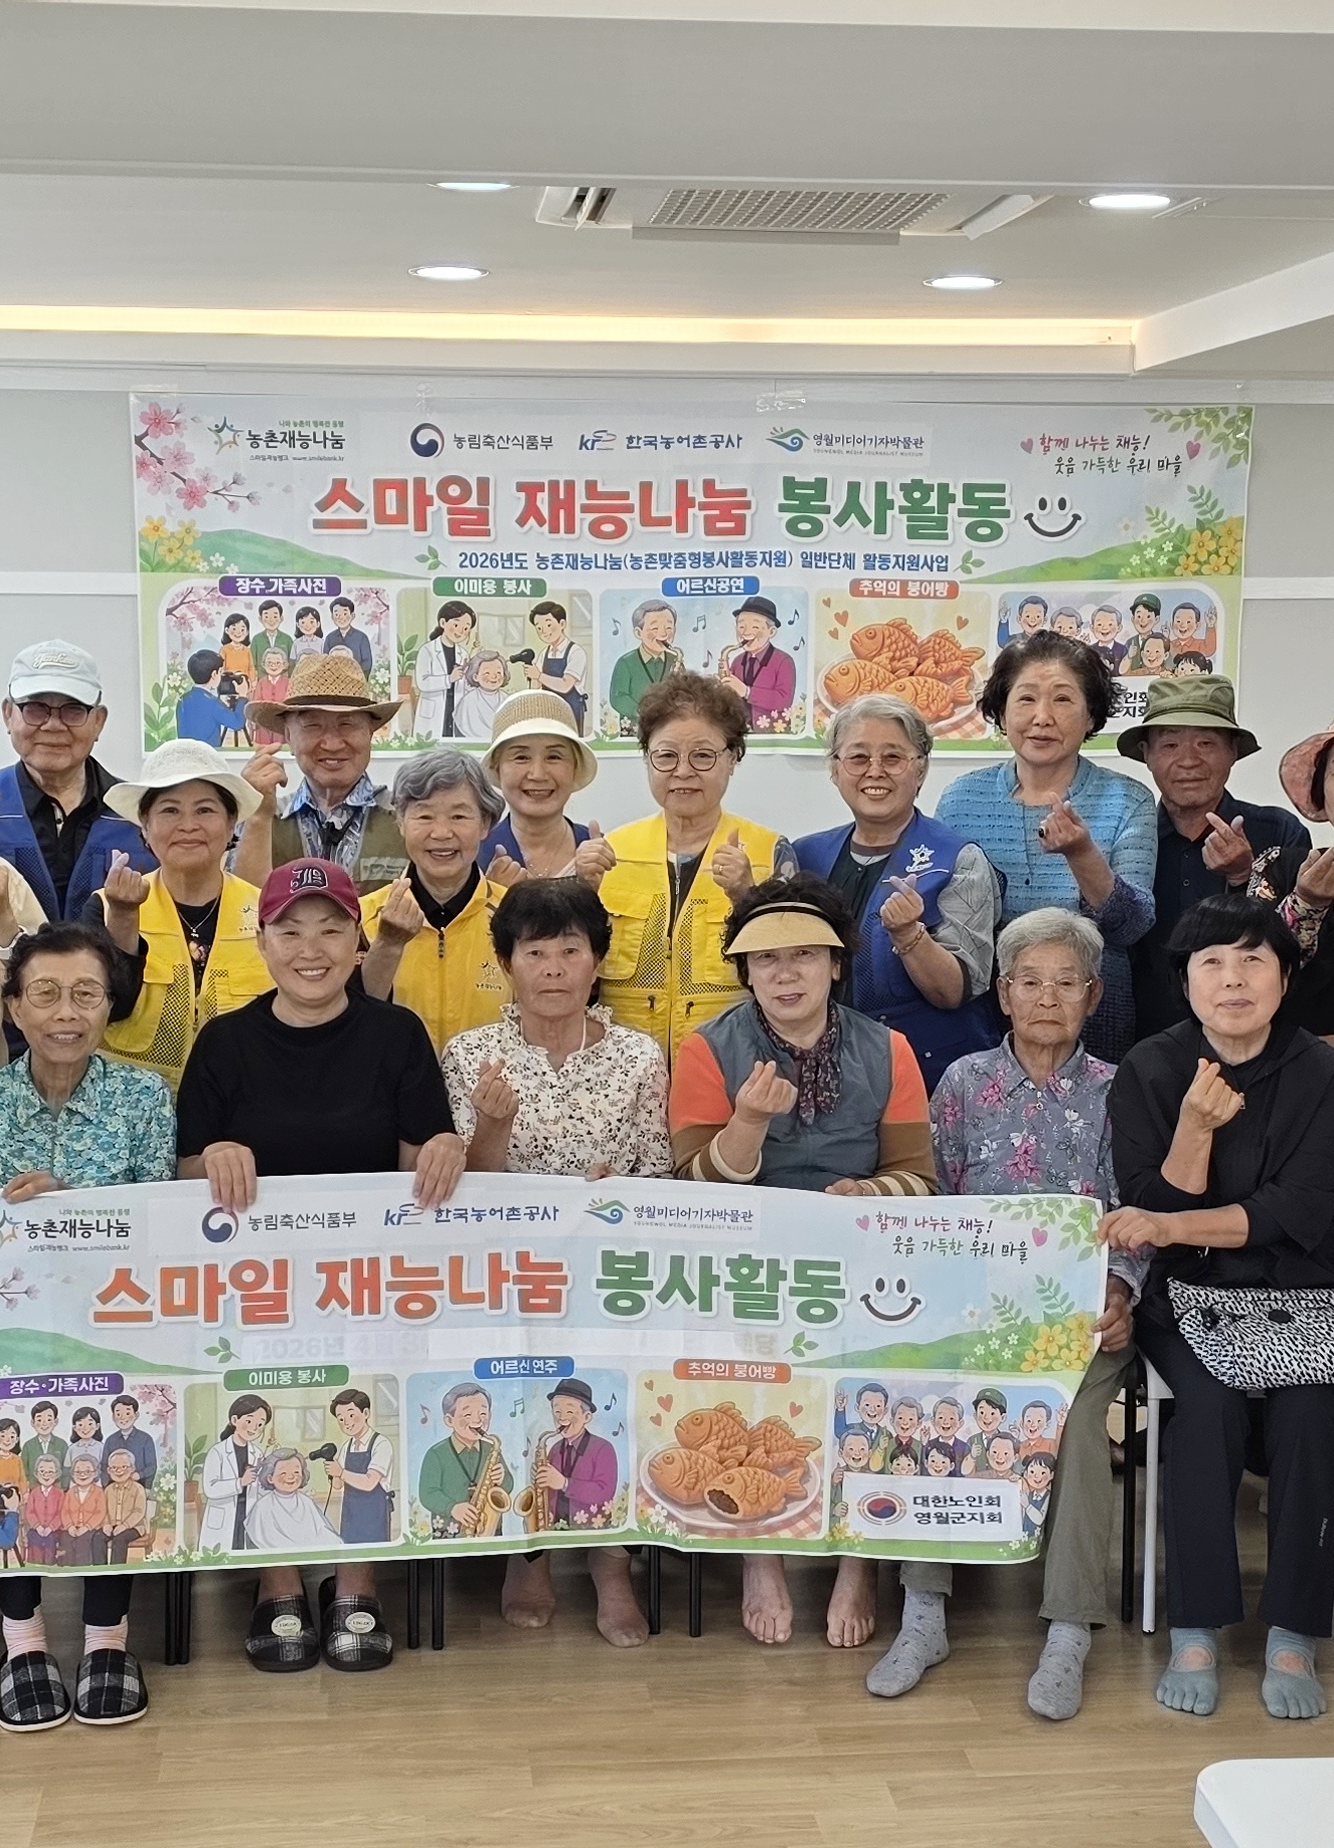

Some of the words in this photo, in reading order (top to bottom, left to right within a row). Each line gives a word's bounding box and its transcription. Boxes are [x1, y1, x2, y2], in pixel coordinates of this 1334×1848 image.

[245, 429, 346, 450] 농촌재능나눔
[453, 434, 554, 451] 농림축산식품부
[624, 434, 744, 450] 한국농어촌공사
[813, 433, 924, 449] 영월미디어기자박물관
[1075, 434, 1110, 451] 나누는
[1054, 456, 1076, 477] 웃음
[1082, 456, 1121, 475] 가득한
[1127, 456, 1151, 476] 우리
[1157, 455, 1183, 477] 마을
[312, 475, 492, 538] 스마일
[515, 478, 752, 541] 재능나눔
[777, 476, 1012, 542] 봉사활동
[458, 551, 529, 571] 2026년도
[799, 550, 857, 571] 일반단체
[861, 552, 950, 574] 활동지원사업
[453, 578, 498, 595] 이미용
[502, 578, 532, 595] 봉사
[676, 579, 744, 595] 어르신공연
[859, 579, 899, 597] 추억의
[906, 580, 948, 598] 붕어빵
[247, 1211, 357, 1232] 농림축산식품부
[434, 1205, 560, 1224] 한국농어촌공사
[633, 1204, 754, 1223] 영월미디어기자박물관
[875, 1211, 908, 1233] 함께
[914, 1215, 952, 1232] 나누는
[24, 1218, 132, 1240] 농촌재능나눔
[892, 1235, 916, 1257] 웃음
[922, 1237, 964, 1257] 가득한
[969, 1240, 995, 1258] 우리
[1001, 1240, 1029, 1265] 마을
[92, 1258, 291, 1325] 스마일
[314, 1250, 568, 1318] 재능나눔
[594, 1248, 847, 1324] 봉사활동
[490, 1360, 530, 1375] 어르신
[532, 1359, 558, 1374] 연주
[687, 1361, 729, 1377] 추억의
[733, 1364, 777, 1380] 붕어빵
[248, 1369, 293, 1387] 이미용
[296, 1369, 327, 1386] 봉사
[913, 1495, 1002, 1508] 대한노인회
[913, 1511, 1003, 1525] 영월군지회
